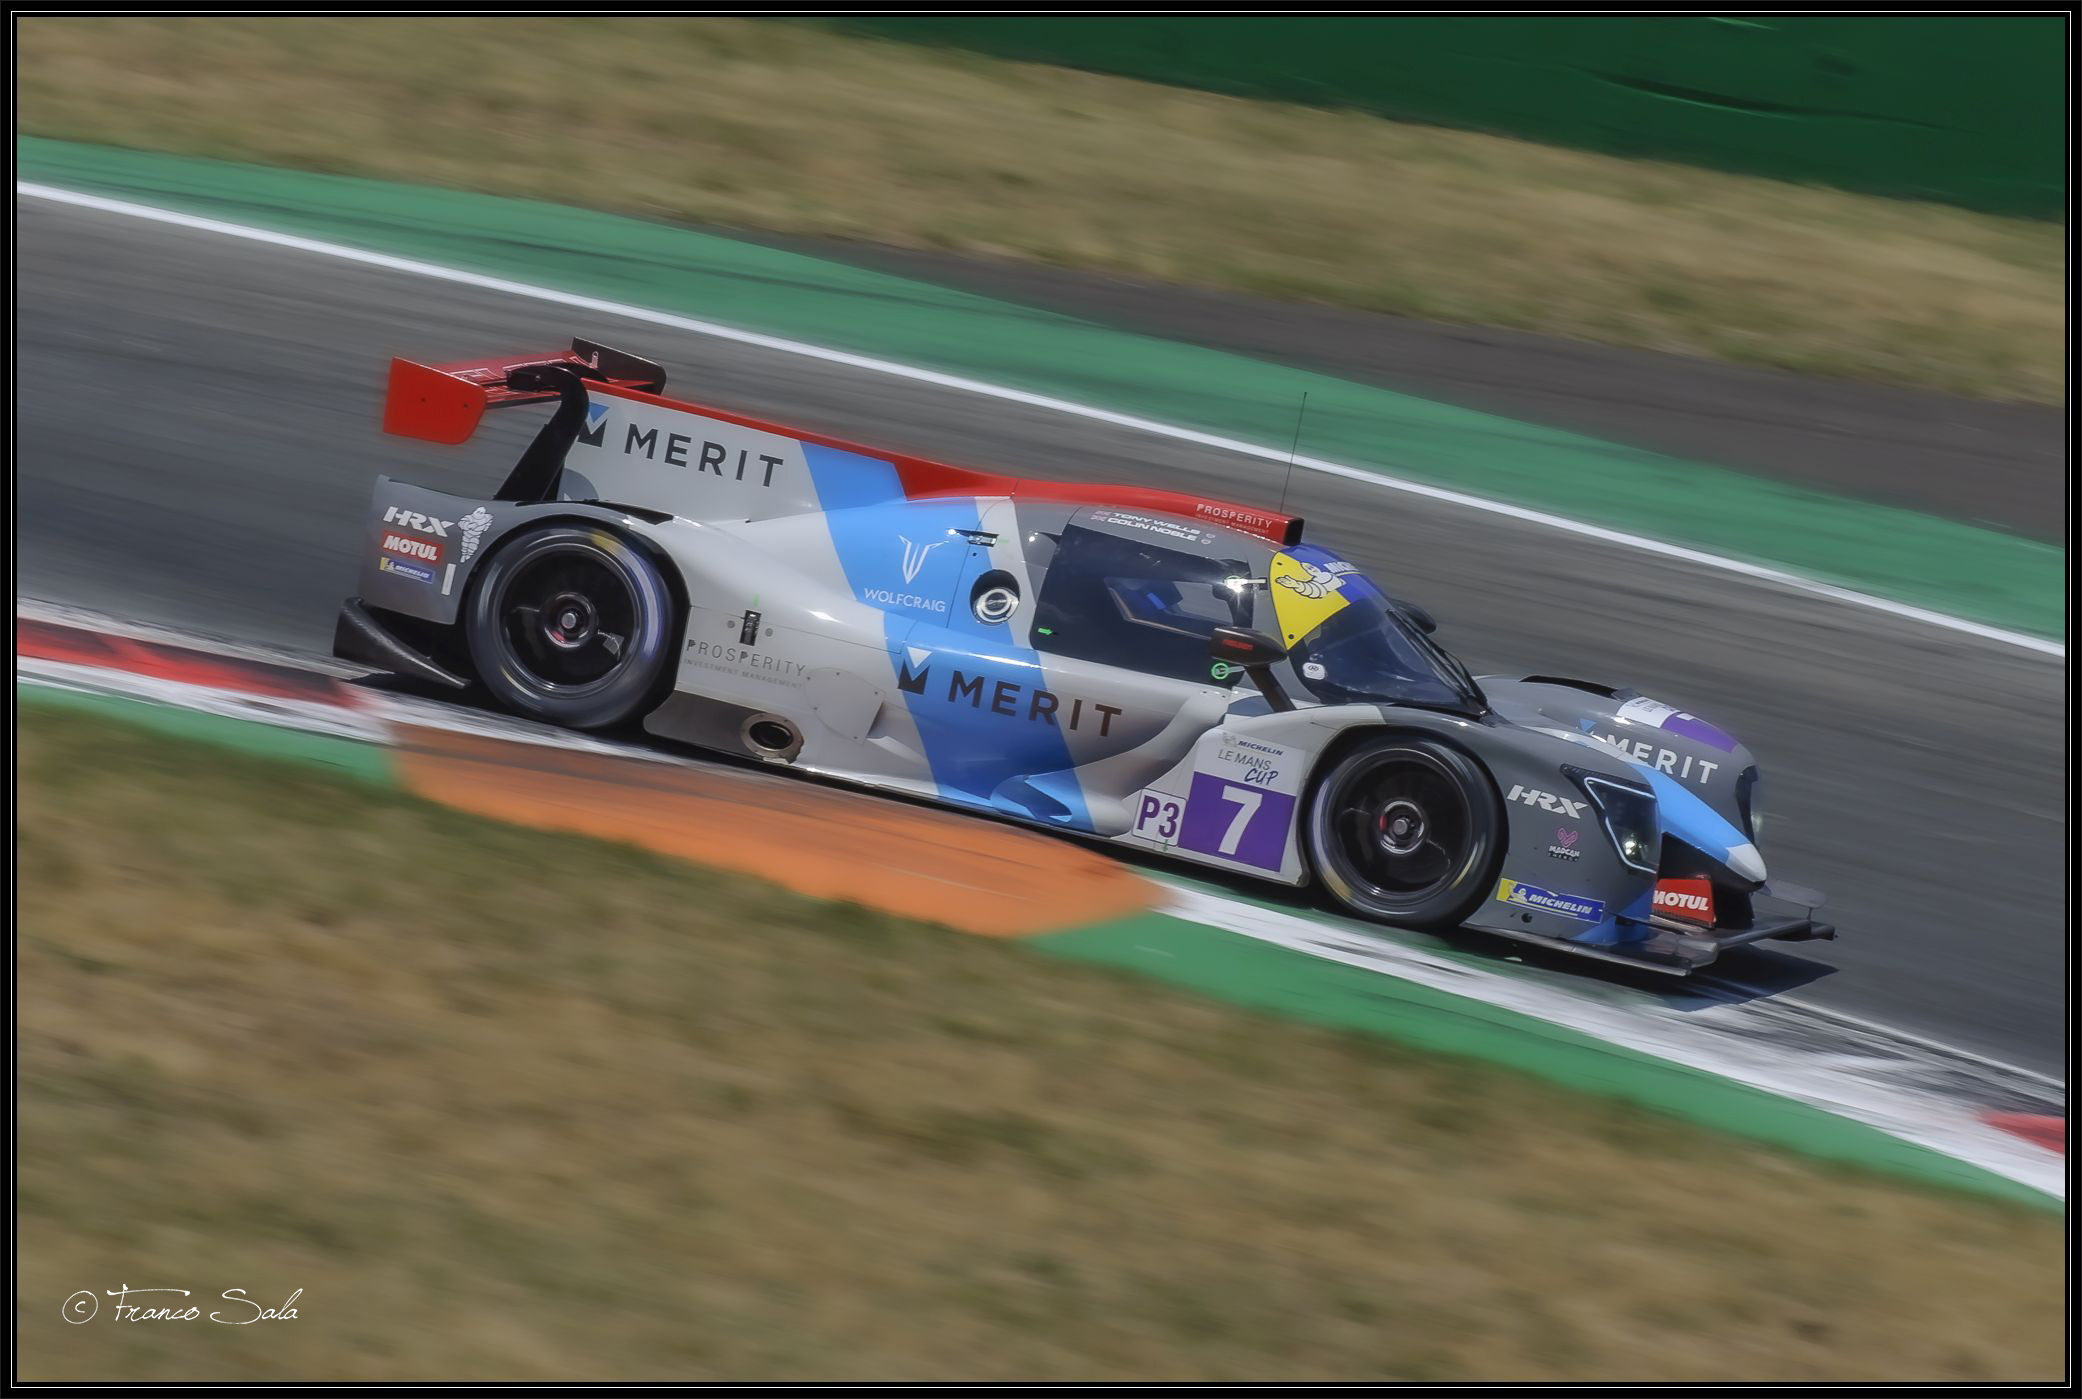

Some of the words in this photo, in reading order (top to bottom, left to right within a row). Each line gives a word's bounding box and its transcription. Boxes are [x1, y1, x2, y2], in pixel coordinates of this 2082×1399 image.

[624, 423, 784, 487] MERIT
[382, 505, 456, 538] HRX
[1112, 512, 1153, 524] TONY
[1153, 519, 1201, 535] WELLS
[1196, 503, 1273, 528] PROSPERITY
[1107, 517, 1151, 531] COLIN
[1149, 525, 1198, 542] NOBLE
[383, 535, 438, 561] MOTUL
[864, 587, 946, 613] WOLFCRAIG
[686, 639, 806, 677] PROSPERITY
[947, 670, 1123, 737] MERIT
[1217, 749, 1232, 762] LE
[1234, 752, 1273, 771] MANS
[1237, 740, 1285, 756] MICHELIN
[1606, 734, 1719, 784] MERIT
[1244, 767, 1279, 786] CUP
[1506, 784, 1589, 819] HRX
[1136, 794, 1180, 839] P3
[1218, 784, 1263, 856] 7
[1528, 894, 1593, 915] MICHELIN
